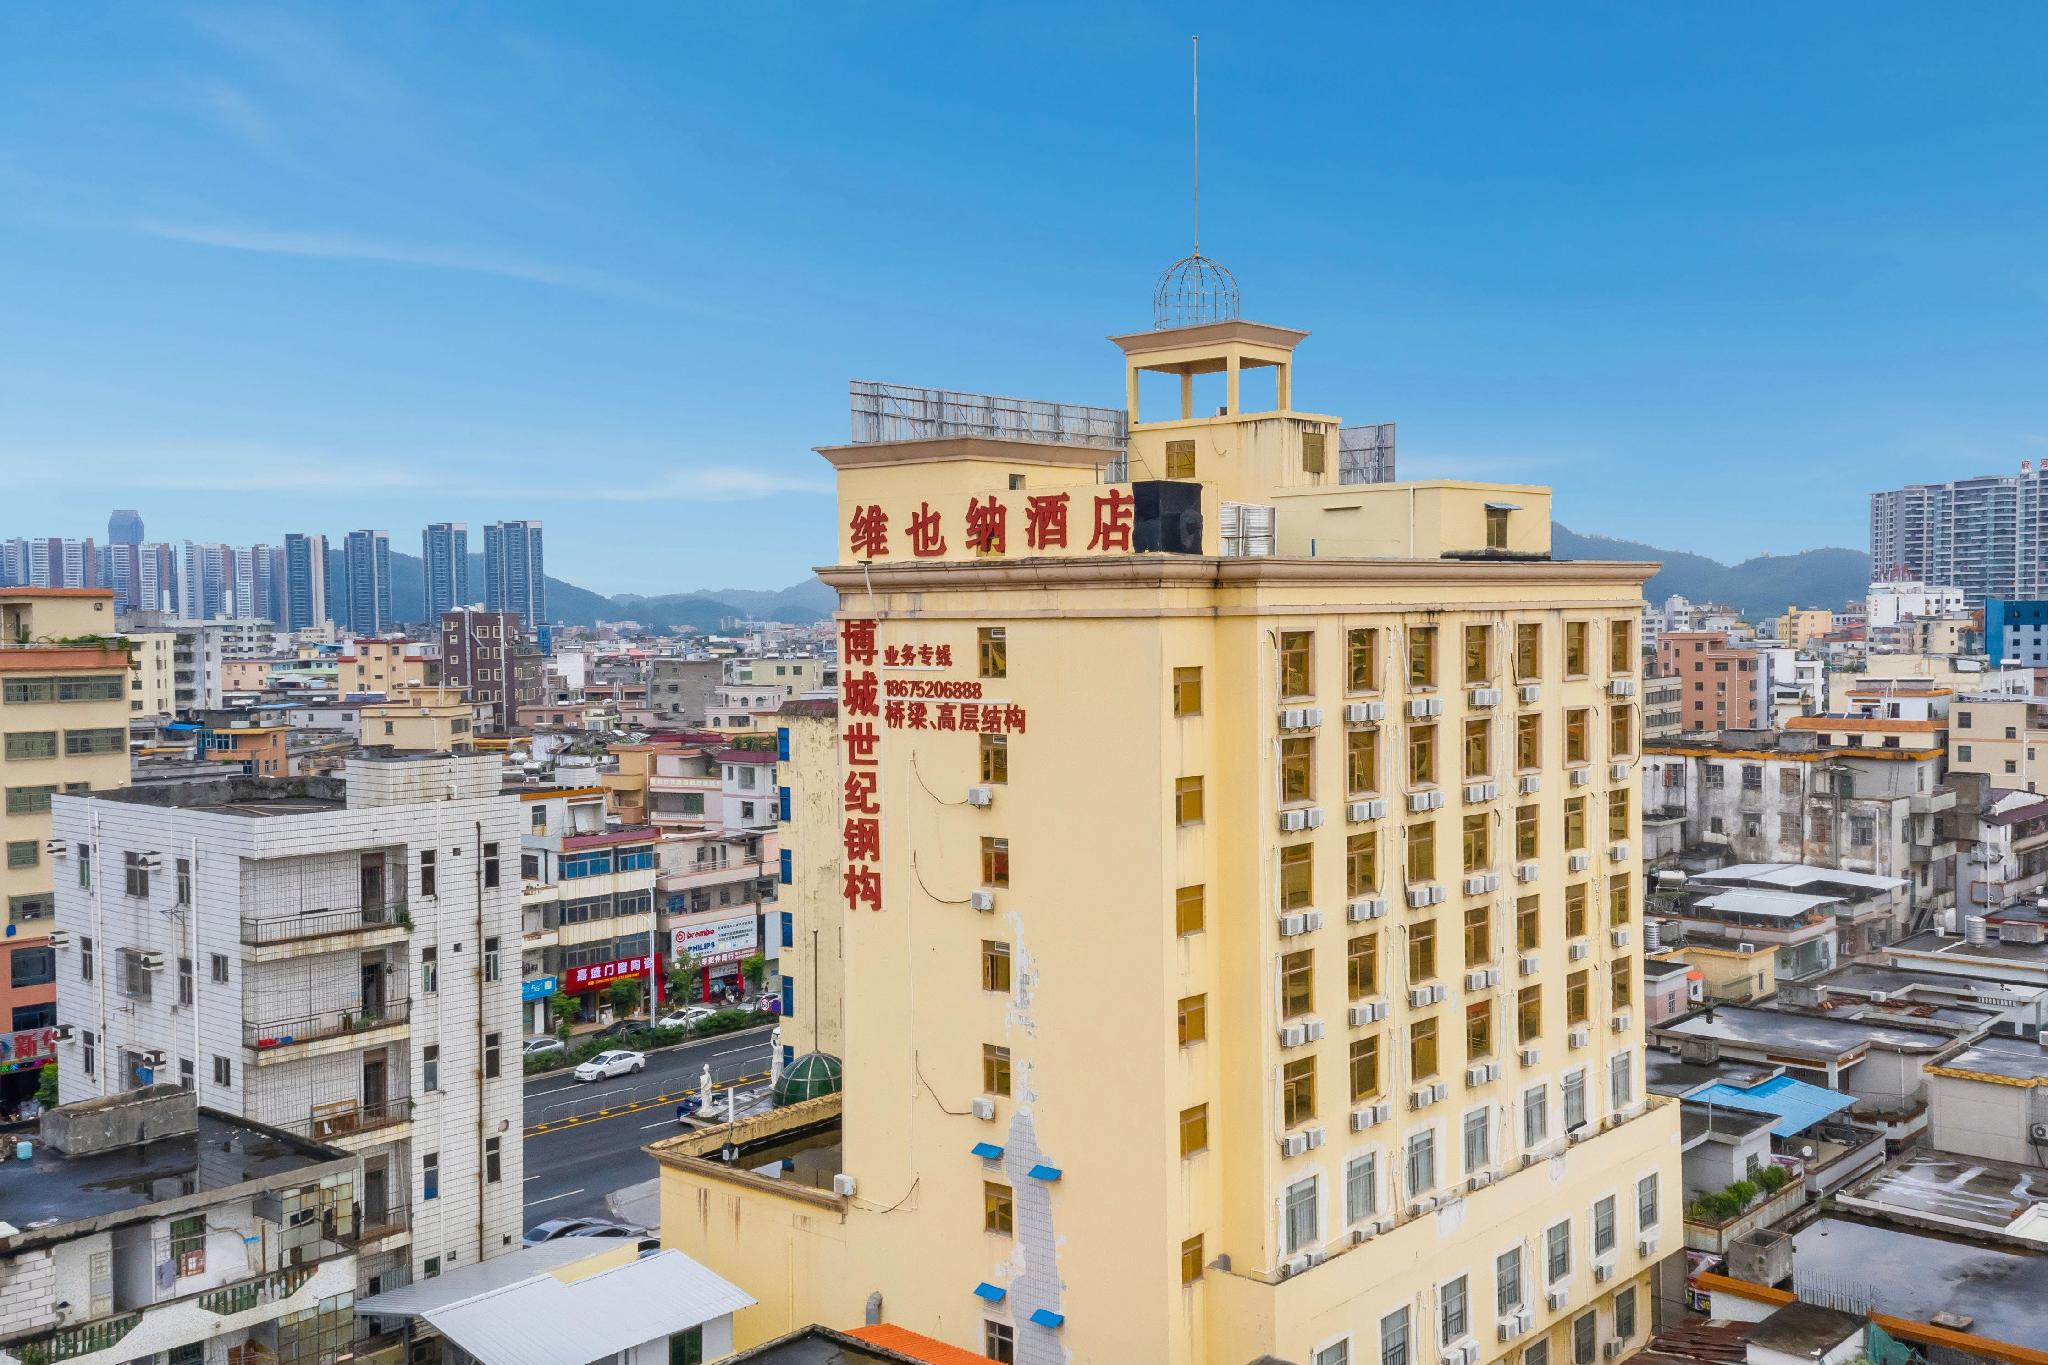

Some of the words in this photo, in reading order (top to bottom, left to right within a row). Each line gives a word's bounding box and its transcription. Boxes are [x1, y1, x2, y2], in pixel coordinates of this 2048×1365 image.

[850, 489, 1134, 558] 维也纳酒店
[884, 680, 983, 699] 18675206888
[884, 700, 1027, 734] 桥梁、高层结构
[841, 619, 882, 911] 博城世纪钢构
[686, 928, 715, 940] brembo
[686, 941, 716, 953] PHILIPS
